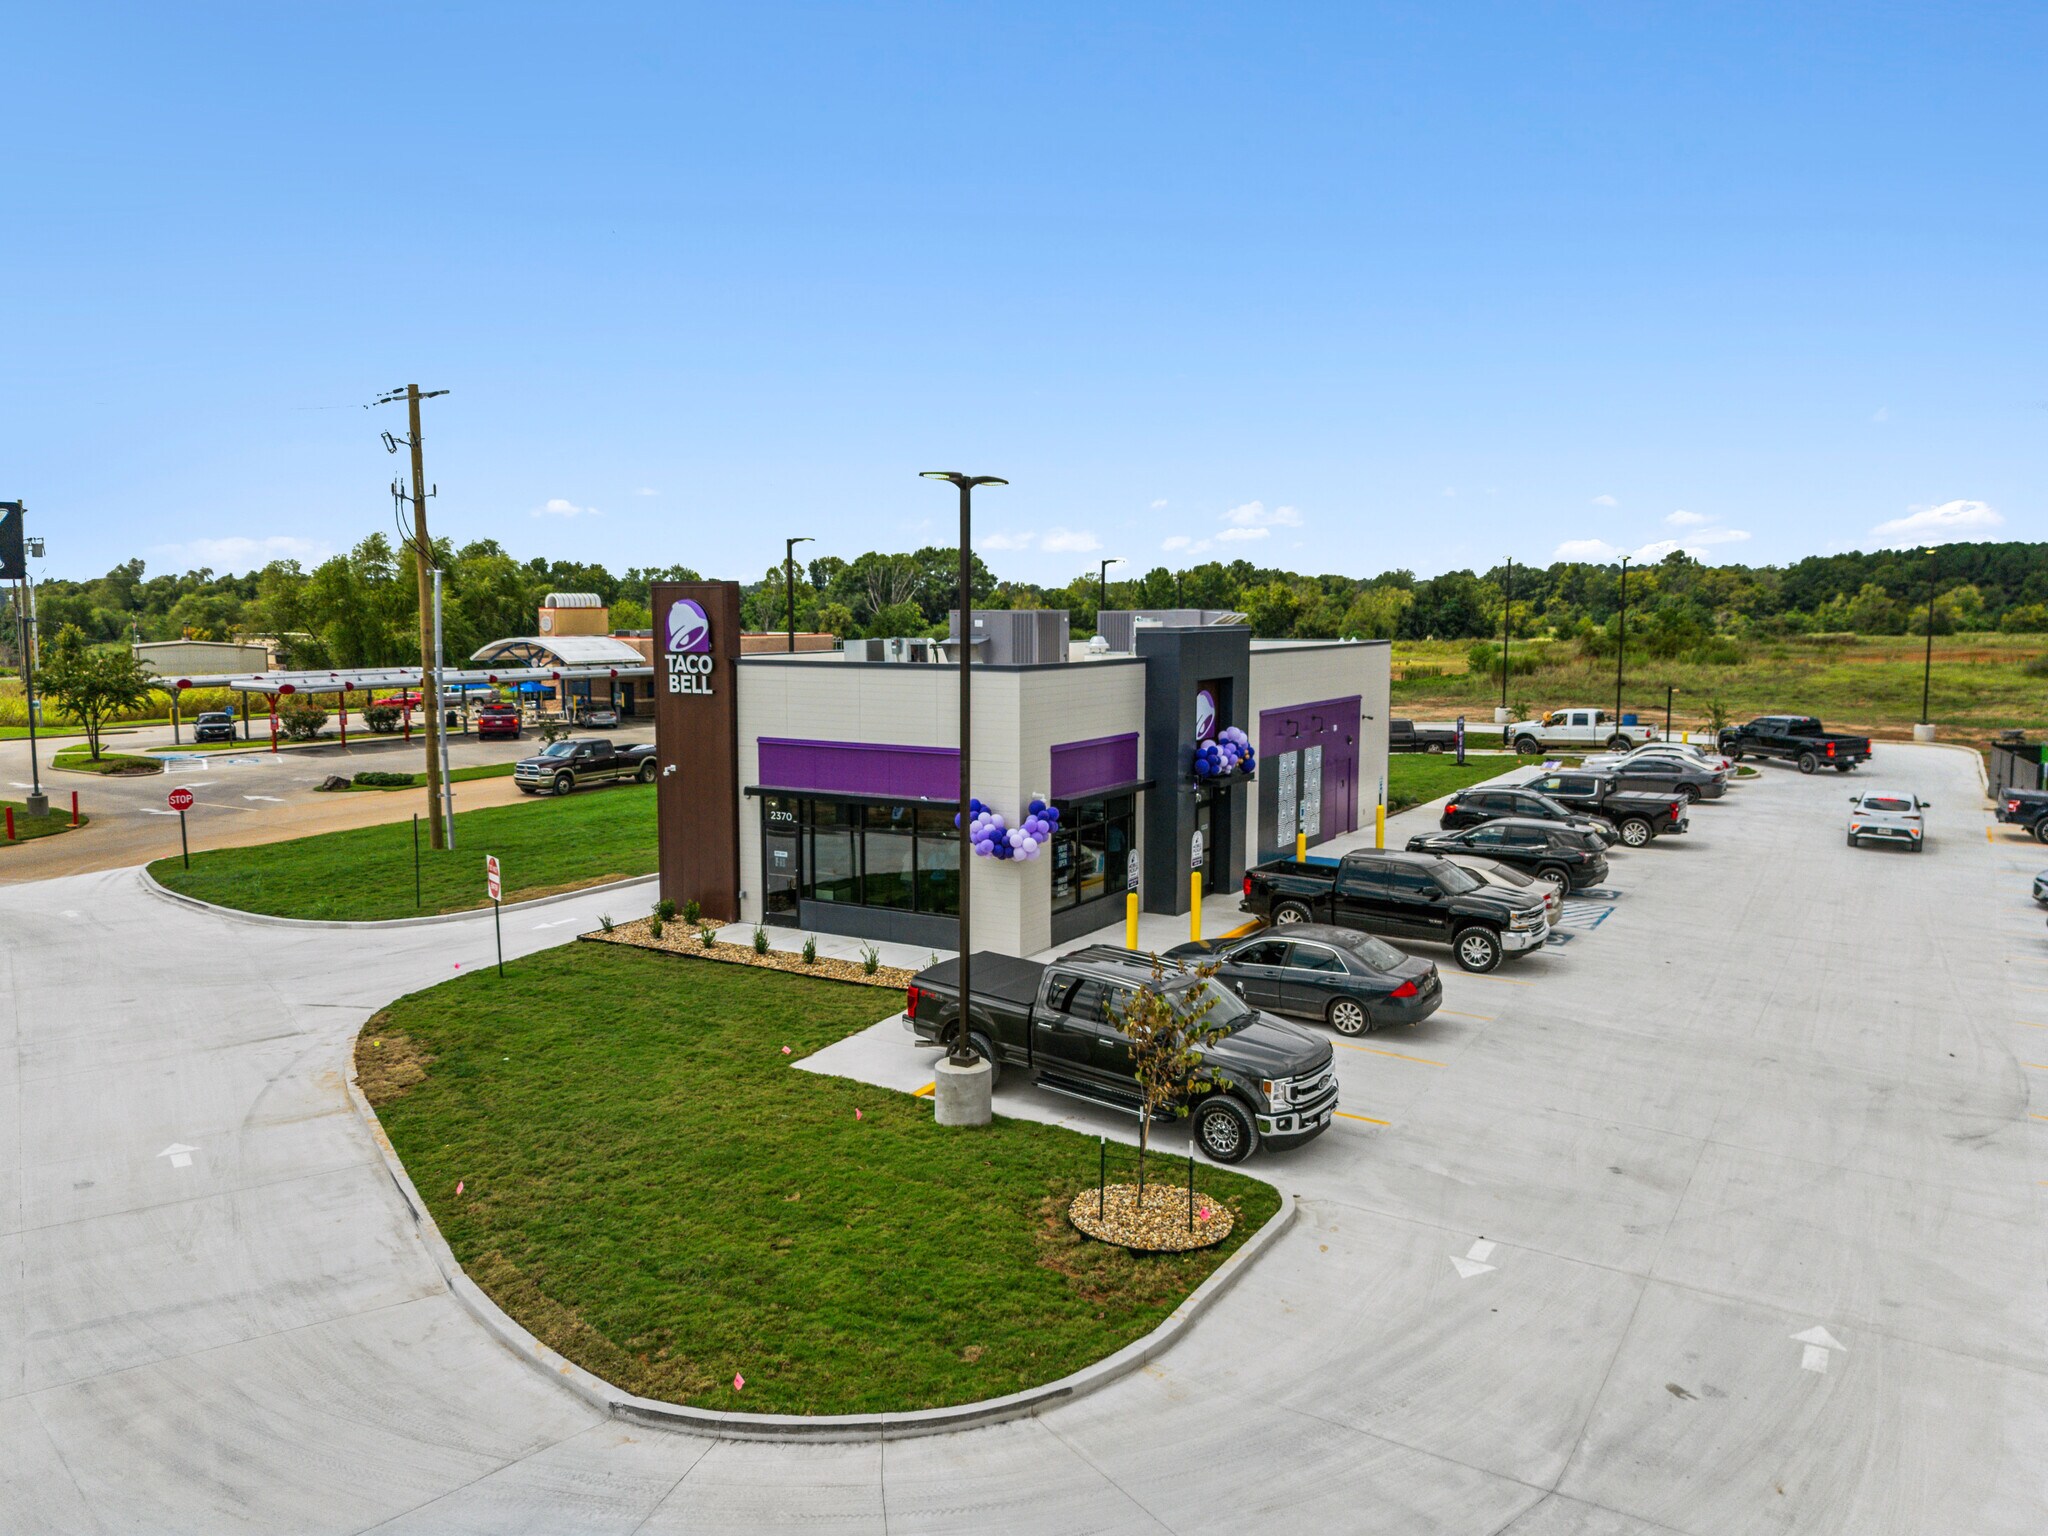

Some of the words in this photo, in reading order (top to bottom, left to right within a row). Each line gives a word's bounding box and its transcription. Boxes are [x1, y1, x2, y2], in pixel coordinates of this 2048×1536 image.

[664, 654, 713, 674] TACO
[669, 674, 713, 694] BELL
[169, 795, 192, 805] STOP
[770, 811, 792, 821] 2370
